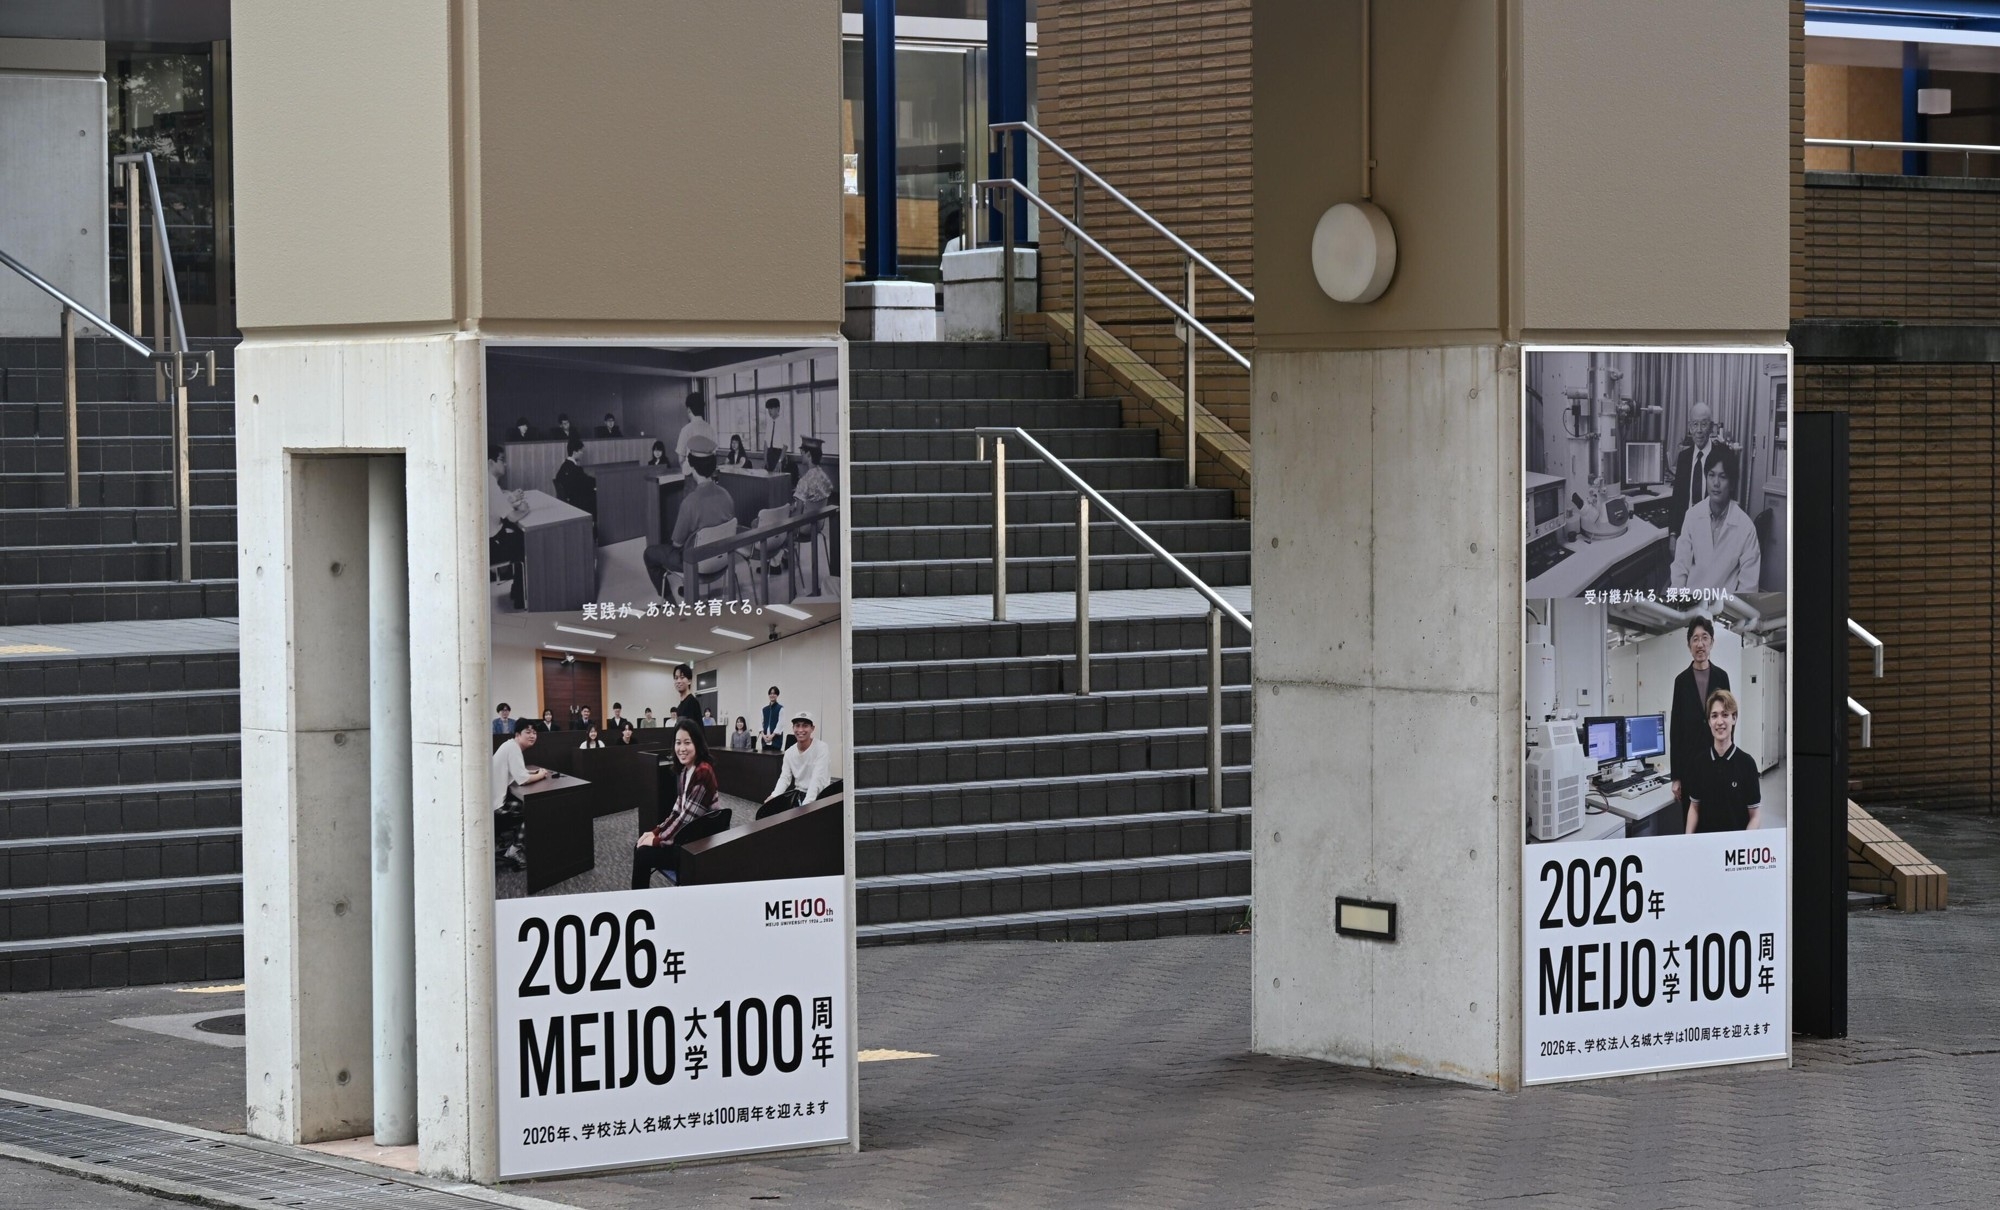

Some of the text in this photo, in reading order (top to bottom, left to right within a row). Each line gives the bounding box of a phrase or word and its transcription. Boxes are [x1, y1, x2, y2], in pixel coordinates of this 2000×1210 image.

[582, 598, 763, 621] 実践が、あなたを育てる。
[1584, 587, 1735, 606] 受け継がれる、探究のDNA。
[1540, 1021, 1771, 1057] 2026年、学校法人名城大学は100周年を迎えます
[522, 1099, 830, 1146] 2026年、学校法人名城大学は100周年を迎えます
